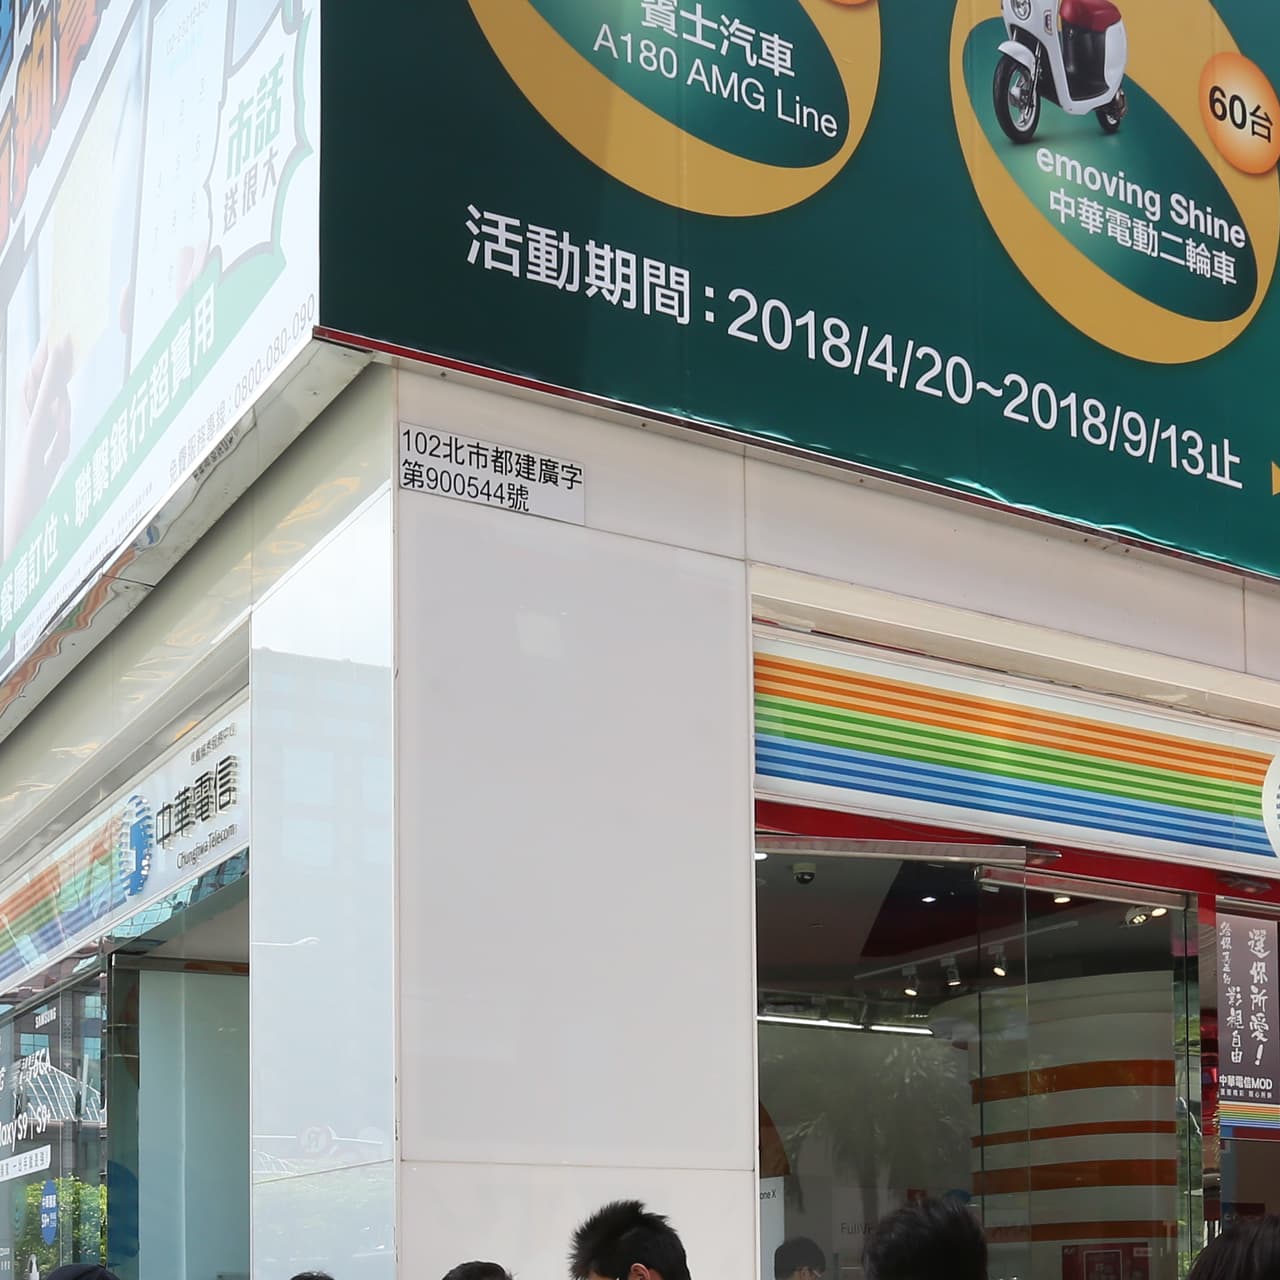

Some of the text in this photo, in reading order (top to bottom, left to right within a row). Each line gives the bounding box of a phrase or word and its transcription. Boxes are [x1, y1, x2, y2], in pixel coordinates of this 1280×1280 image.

[593, 24, 839, 139] A180 AMG Line
[1207, 84, 1275, 144] 60台
[1036, 145, 1246, 249] emoving Shine
[1048, 189, 1238, 286] 中華電動二輪車
[401, 428, 583, 490] 102北市都建廣字
[401, 459, 530, 513] 第900544號
[156, 755, 237, 848] 中華電信
[207, 823, 237, 850] Telecom
[35, 1007, 57, 1029] SAMSUNG
